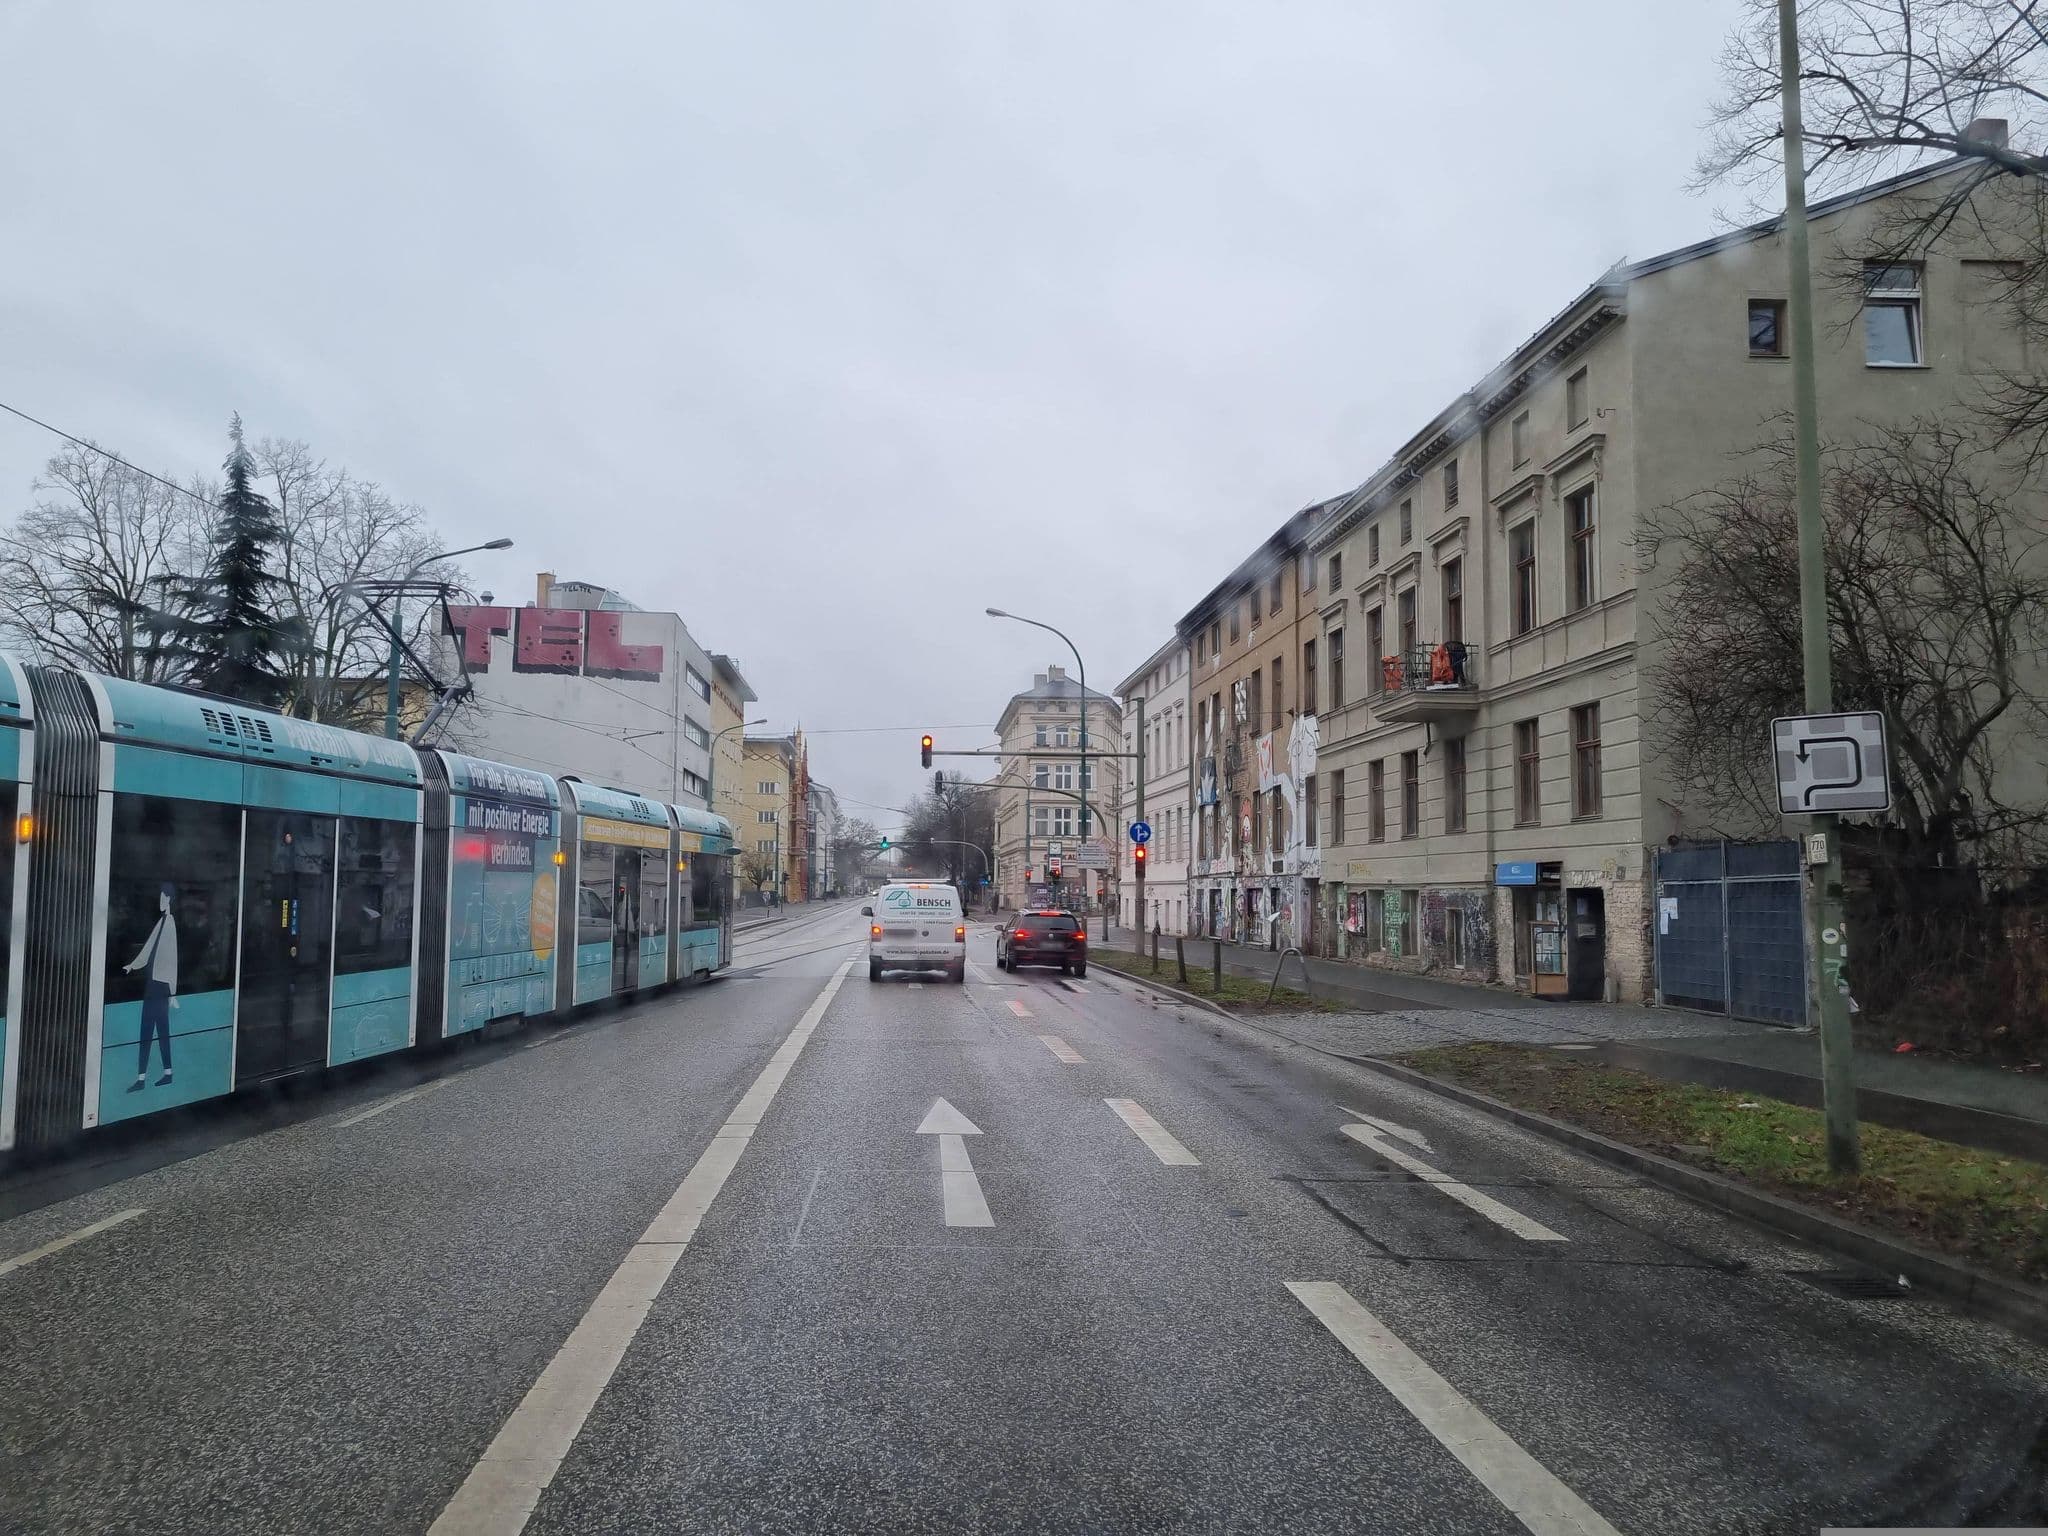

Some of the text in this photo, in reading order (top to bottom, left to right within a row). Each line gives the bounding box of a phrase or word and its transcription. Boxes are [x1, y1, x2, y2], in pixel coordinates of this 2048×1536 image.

[467, 762, 486, 787] Für
[504, 769, 520, 794] die
[468, 801, 549, 838] mit positiver Energie
[491, 840, 532, 866] verbinden.
[1810, 839, 1825, 851] 770
[916, 898, 951, 907] BENSCH
